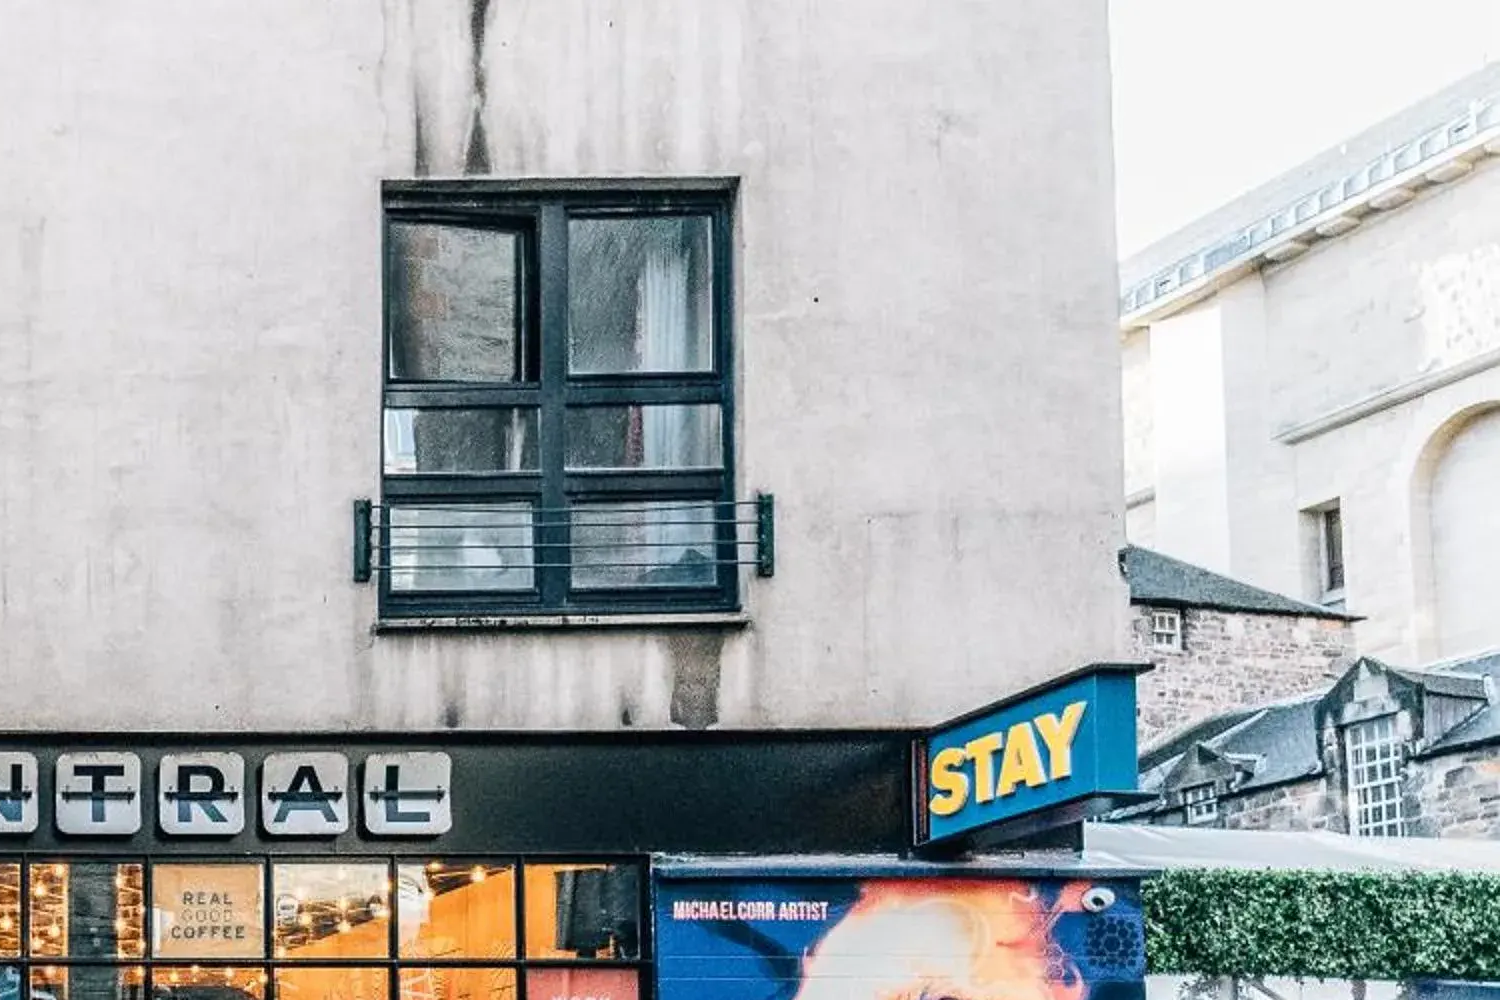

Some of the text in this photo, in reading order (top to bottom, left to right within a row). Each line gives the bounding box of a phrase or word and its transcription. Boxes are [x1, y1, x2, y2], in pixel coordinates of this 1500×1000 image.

[929, 701, 1087, 815] STAY
[182, 891, 233, 905] REAL
[777, 901, 829, 921] ARTIST
[171, 925, 245, 939] COFFEE
